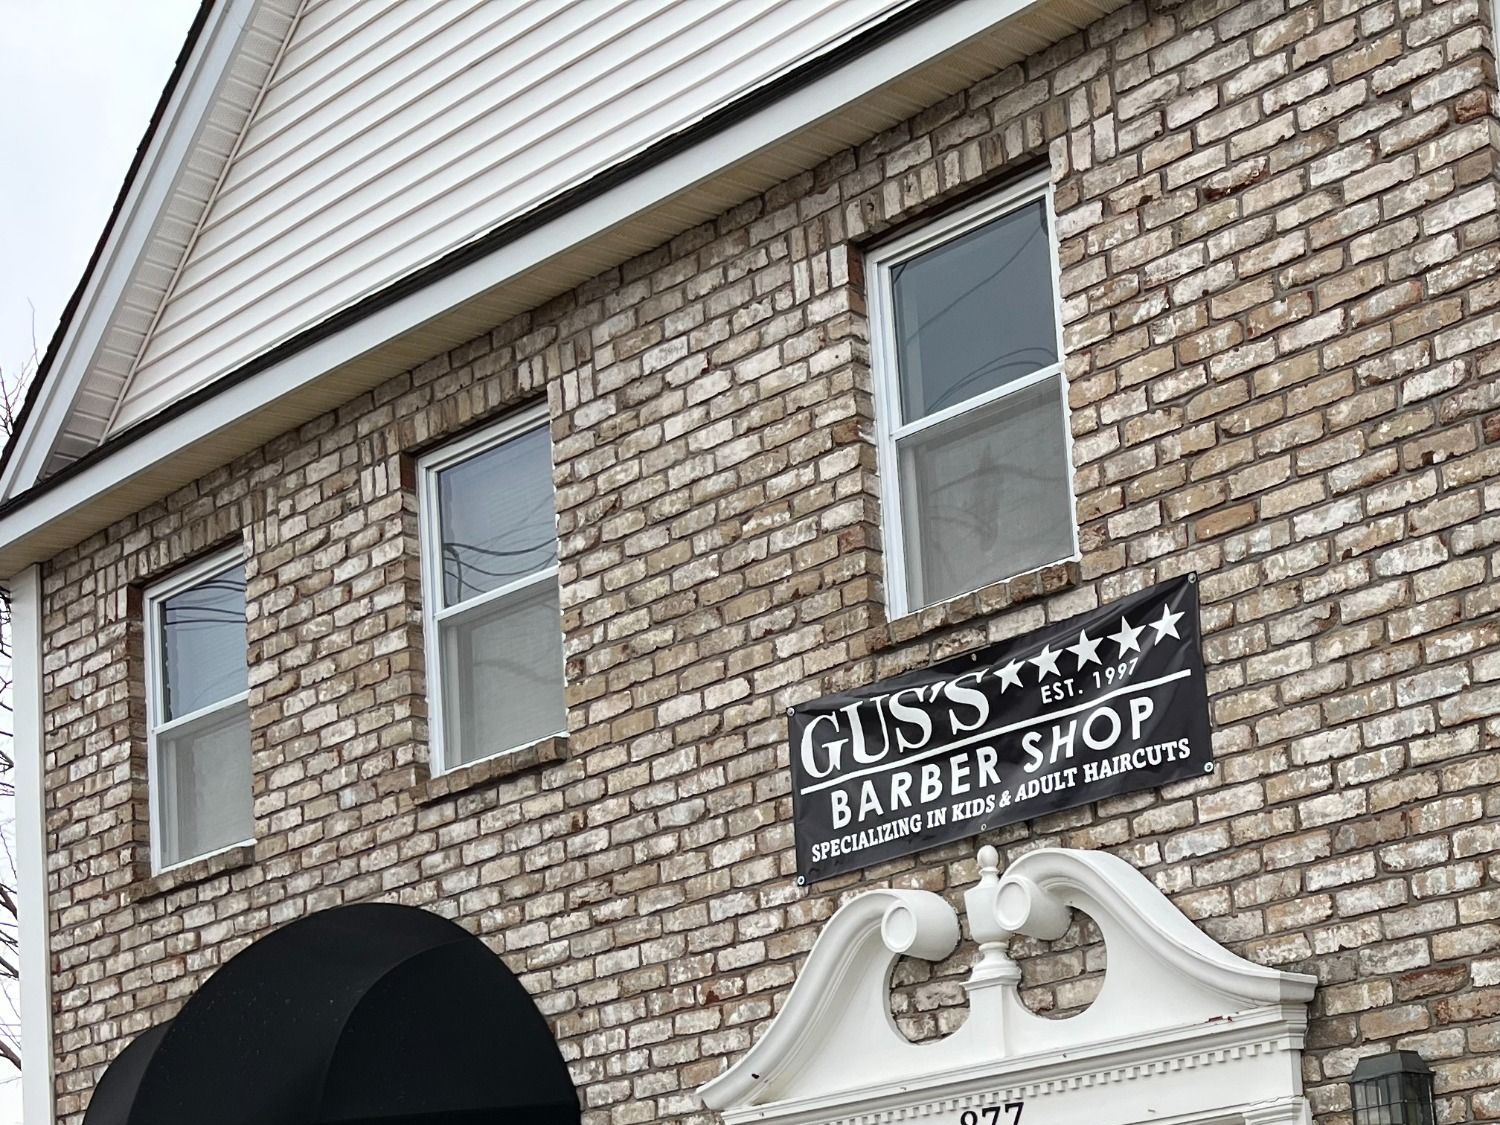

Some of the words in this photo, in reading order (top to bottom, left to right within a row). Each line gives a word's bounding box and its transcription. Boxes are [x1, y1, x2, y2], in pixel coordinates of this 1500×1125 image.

[800, 668, 991, 779] GUS'S
[1041, 679, 1084, 704] EST.
[1092, 657, 1140, 689] 1997
[811, 813, 923, 863] SPECIALIZING
[926, 806, 948, 829] IN
[951, 794, 996, 823] KIDS
[998, 790, 1012, 808] &
[1014, 766, 1078, 803] ADULT
[1082, 738, 1191, 784] HAIRCUTS
[830, 745, 1002, 830] BARBER
[1021, 697, 1155, 774] SHOP
